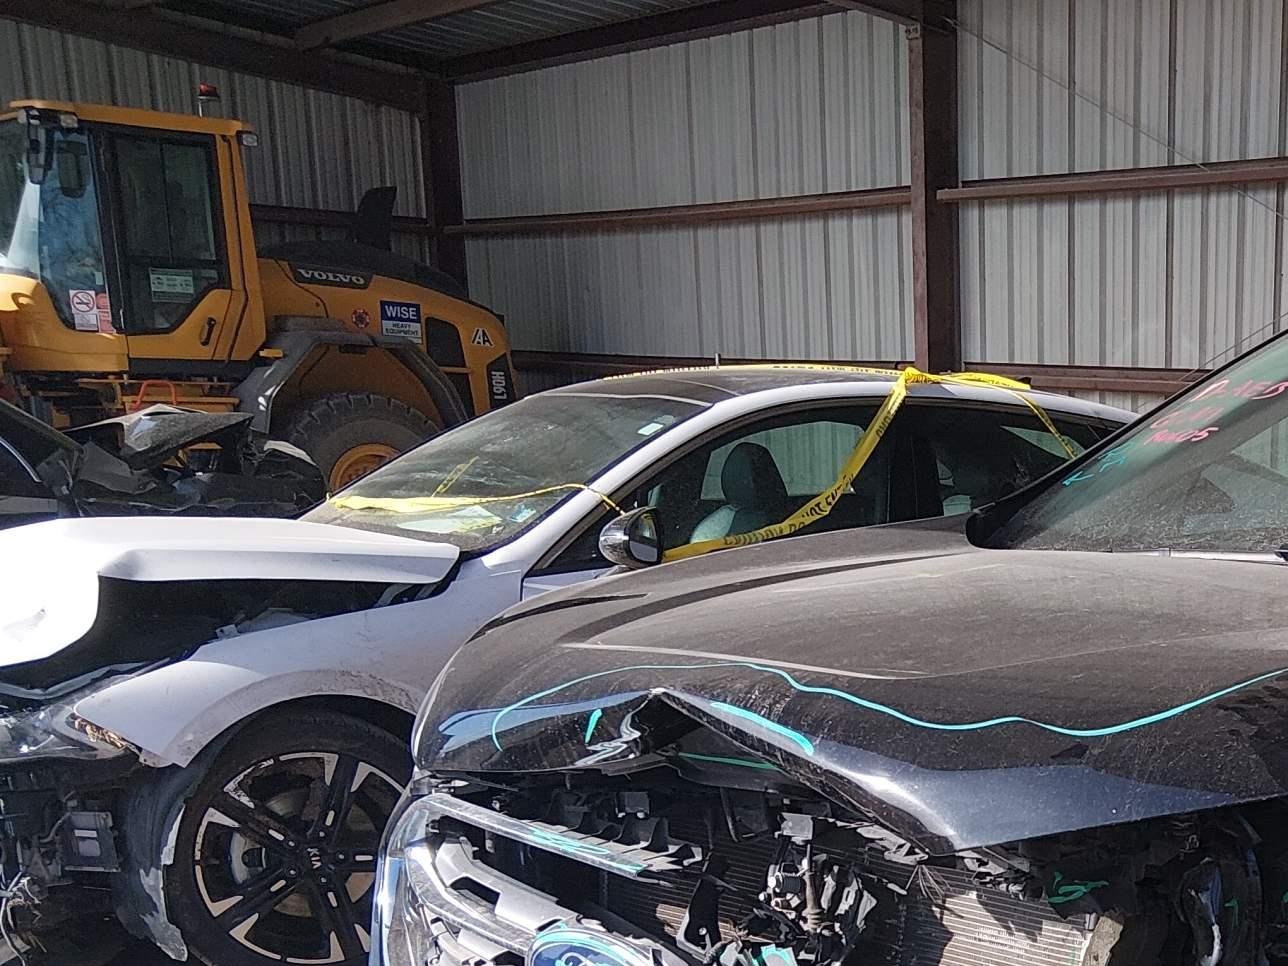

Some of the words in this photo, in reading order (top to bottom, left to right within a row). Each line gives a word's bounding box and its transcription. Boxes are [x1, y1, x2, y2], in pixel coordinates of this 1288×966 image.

[297, 268, 366, 285] VOLVO
[384, 304, 418, 320] WISE
[491, 371, 508, 400] L90H
[307, 847, 322, 869] KIA
